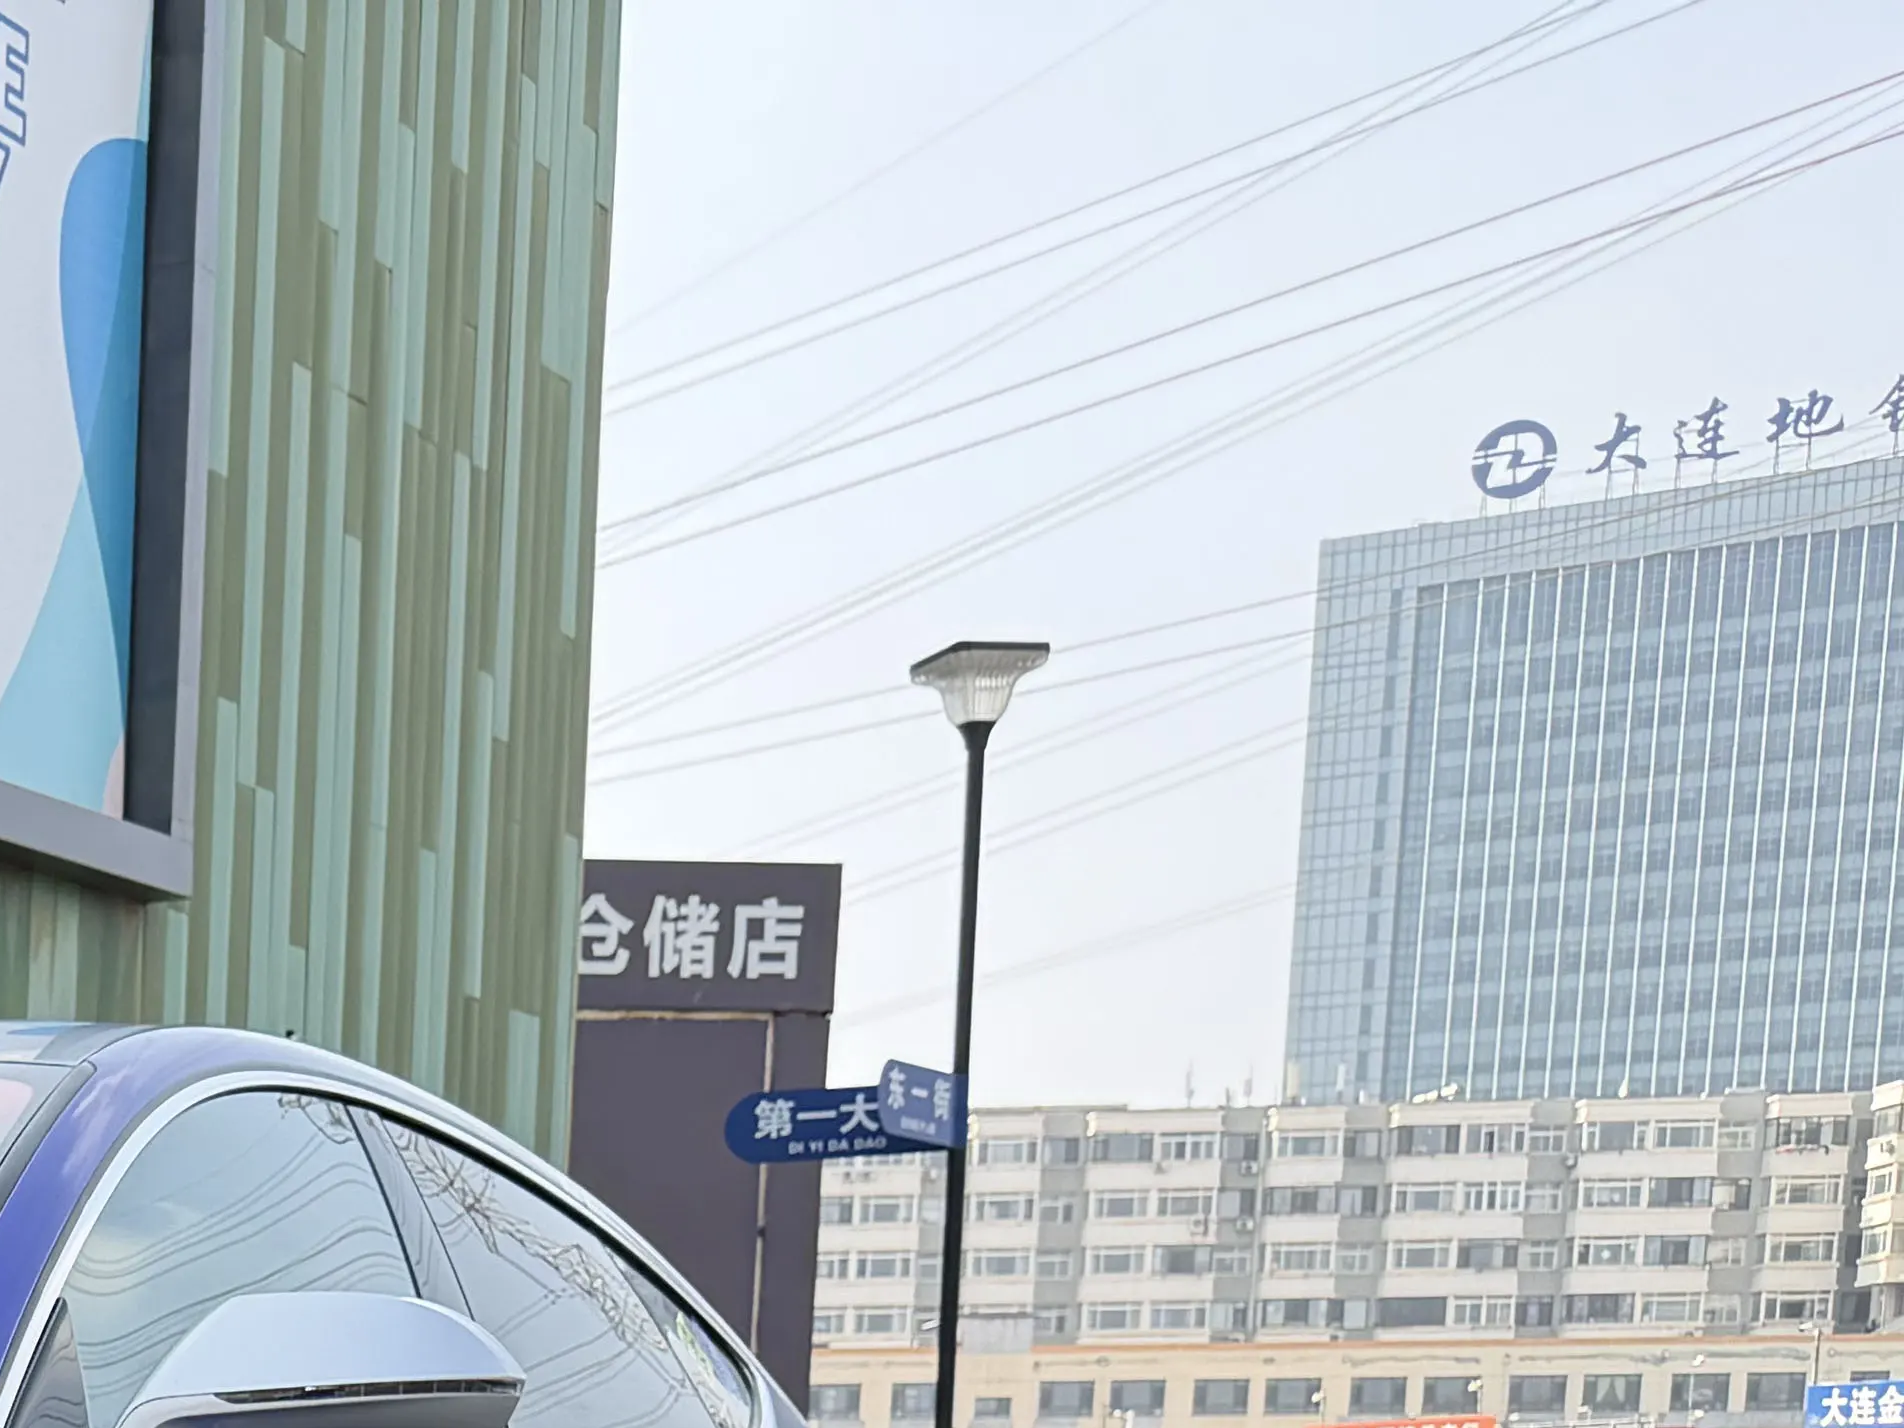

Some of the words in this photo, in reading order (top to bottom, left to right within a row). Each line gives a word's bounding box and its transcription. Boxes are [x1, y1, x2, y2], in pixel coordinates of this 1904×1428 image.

[579, 892, 805, 980] 仓储店
[788, 1140, 805, 1155] DI
[827, 1138, 850, 1153] DA
[853, 1135, 888, 1151] DAO
